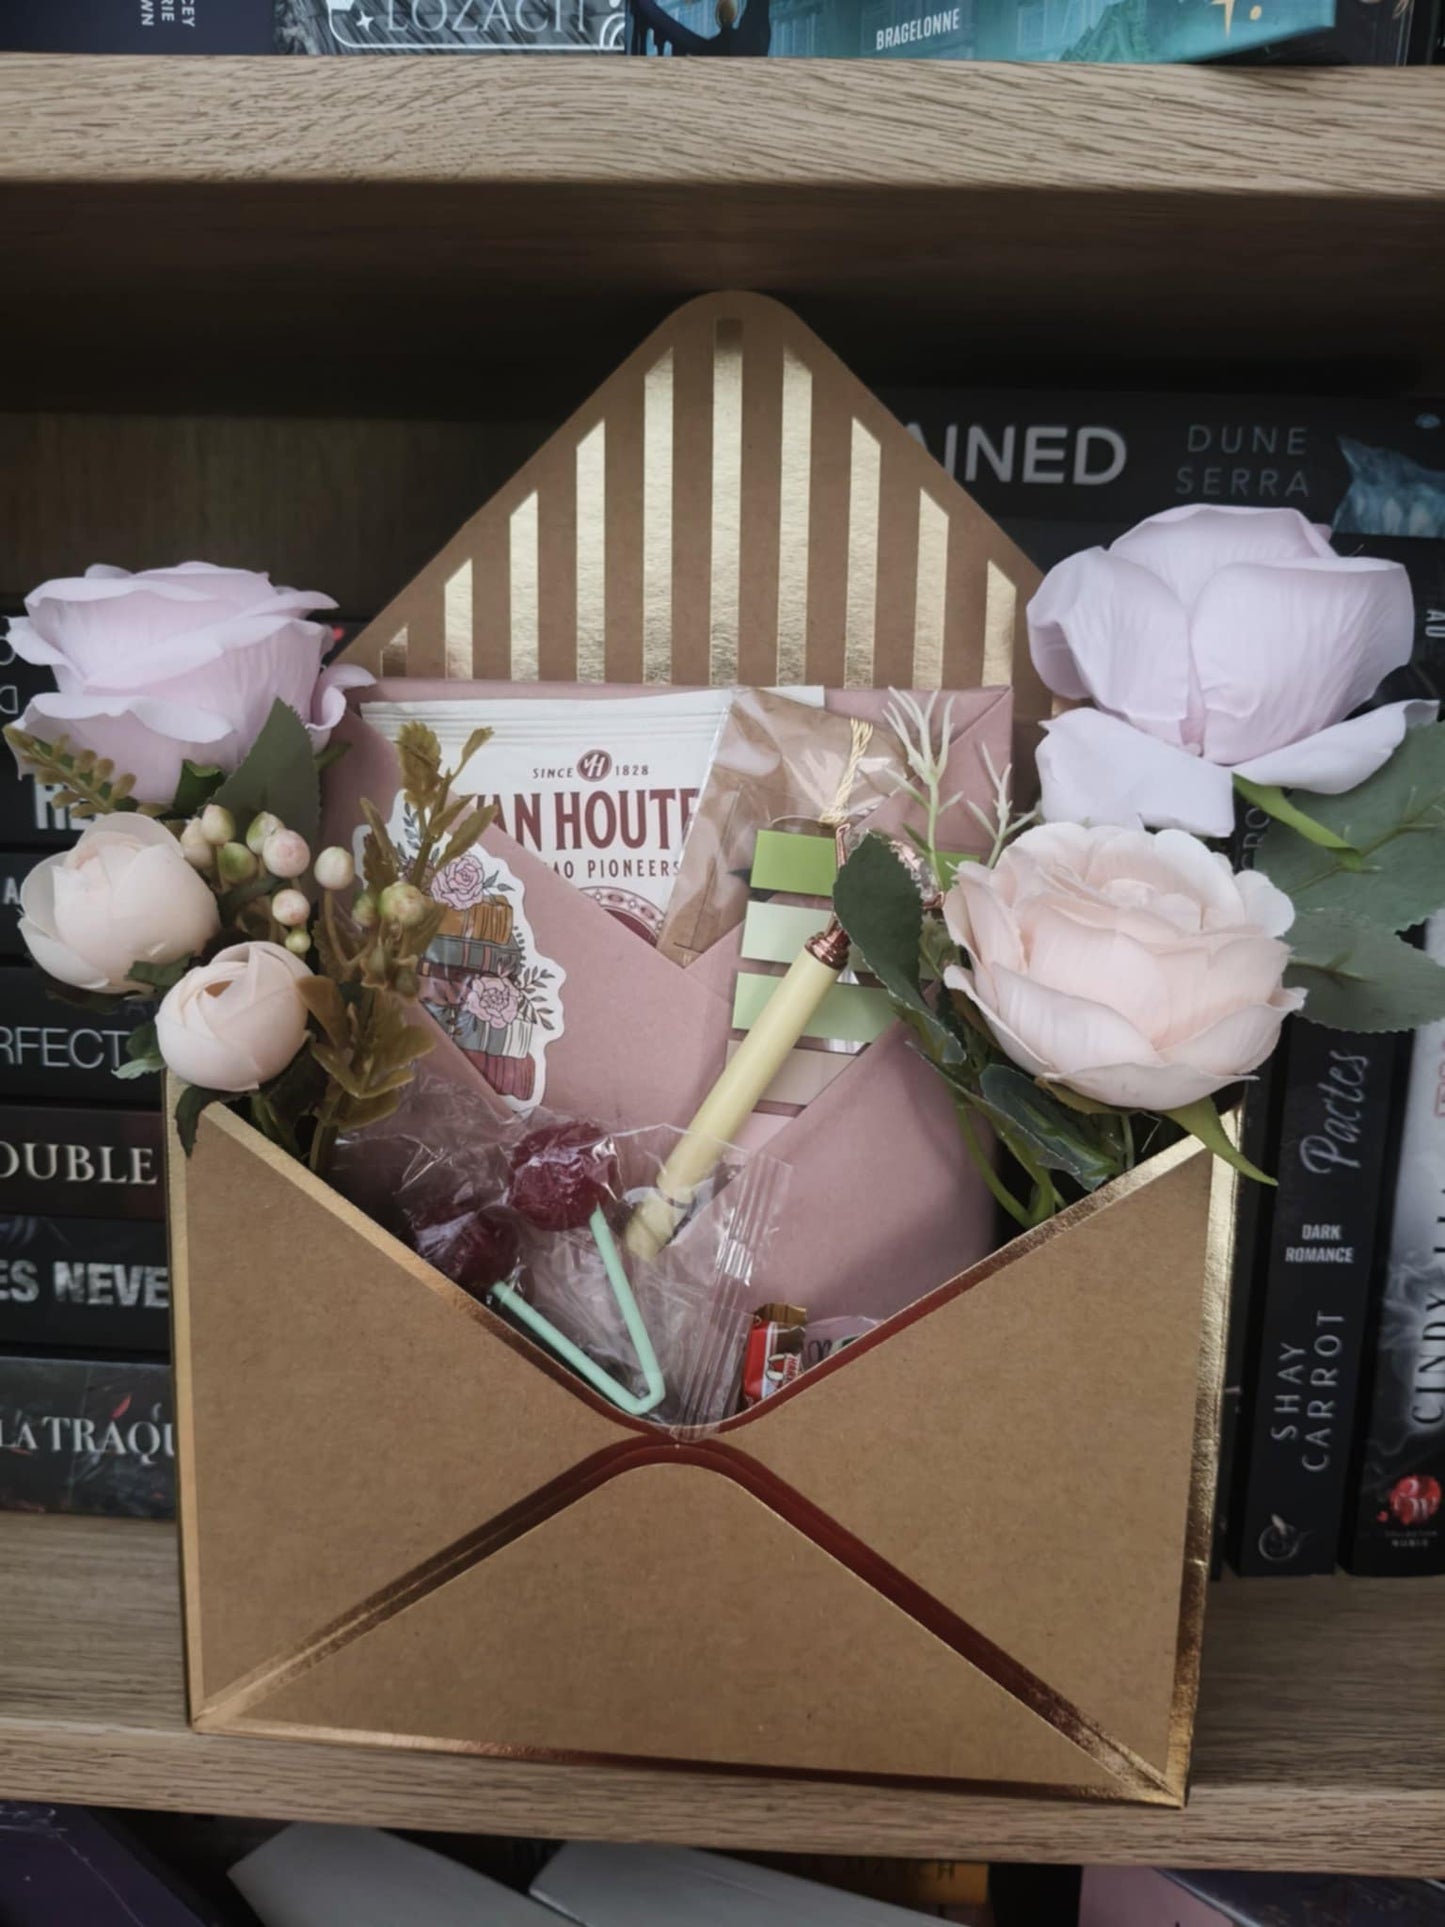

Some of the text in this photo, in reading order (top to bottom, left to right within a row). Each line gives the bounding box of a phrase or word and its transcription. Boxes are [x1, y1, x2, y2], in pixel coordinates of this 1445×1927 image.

[876, 8, 960, 50] BRAGELONNE
[1188, 425, 1309, 456] DUNE
[1176, 467, 1311, 498] SERRA
[533, 767, 574, 779] SINCE
[616, 764, 649, 777] 1828
[1300, 1050, 1368, 1174] Pactes
[1302, 1224, 1342, 1241] DARK
[1285, 1247, 1354, 1264] ROMANCE
[1271, 1342, 1305, 1441] SHAY
[1301, 1310, 1345, 1472] CARROT
